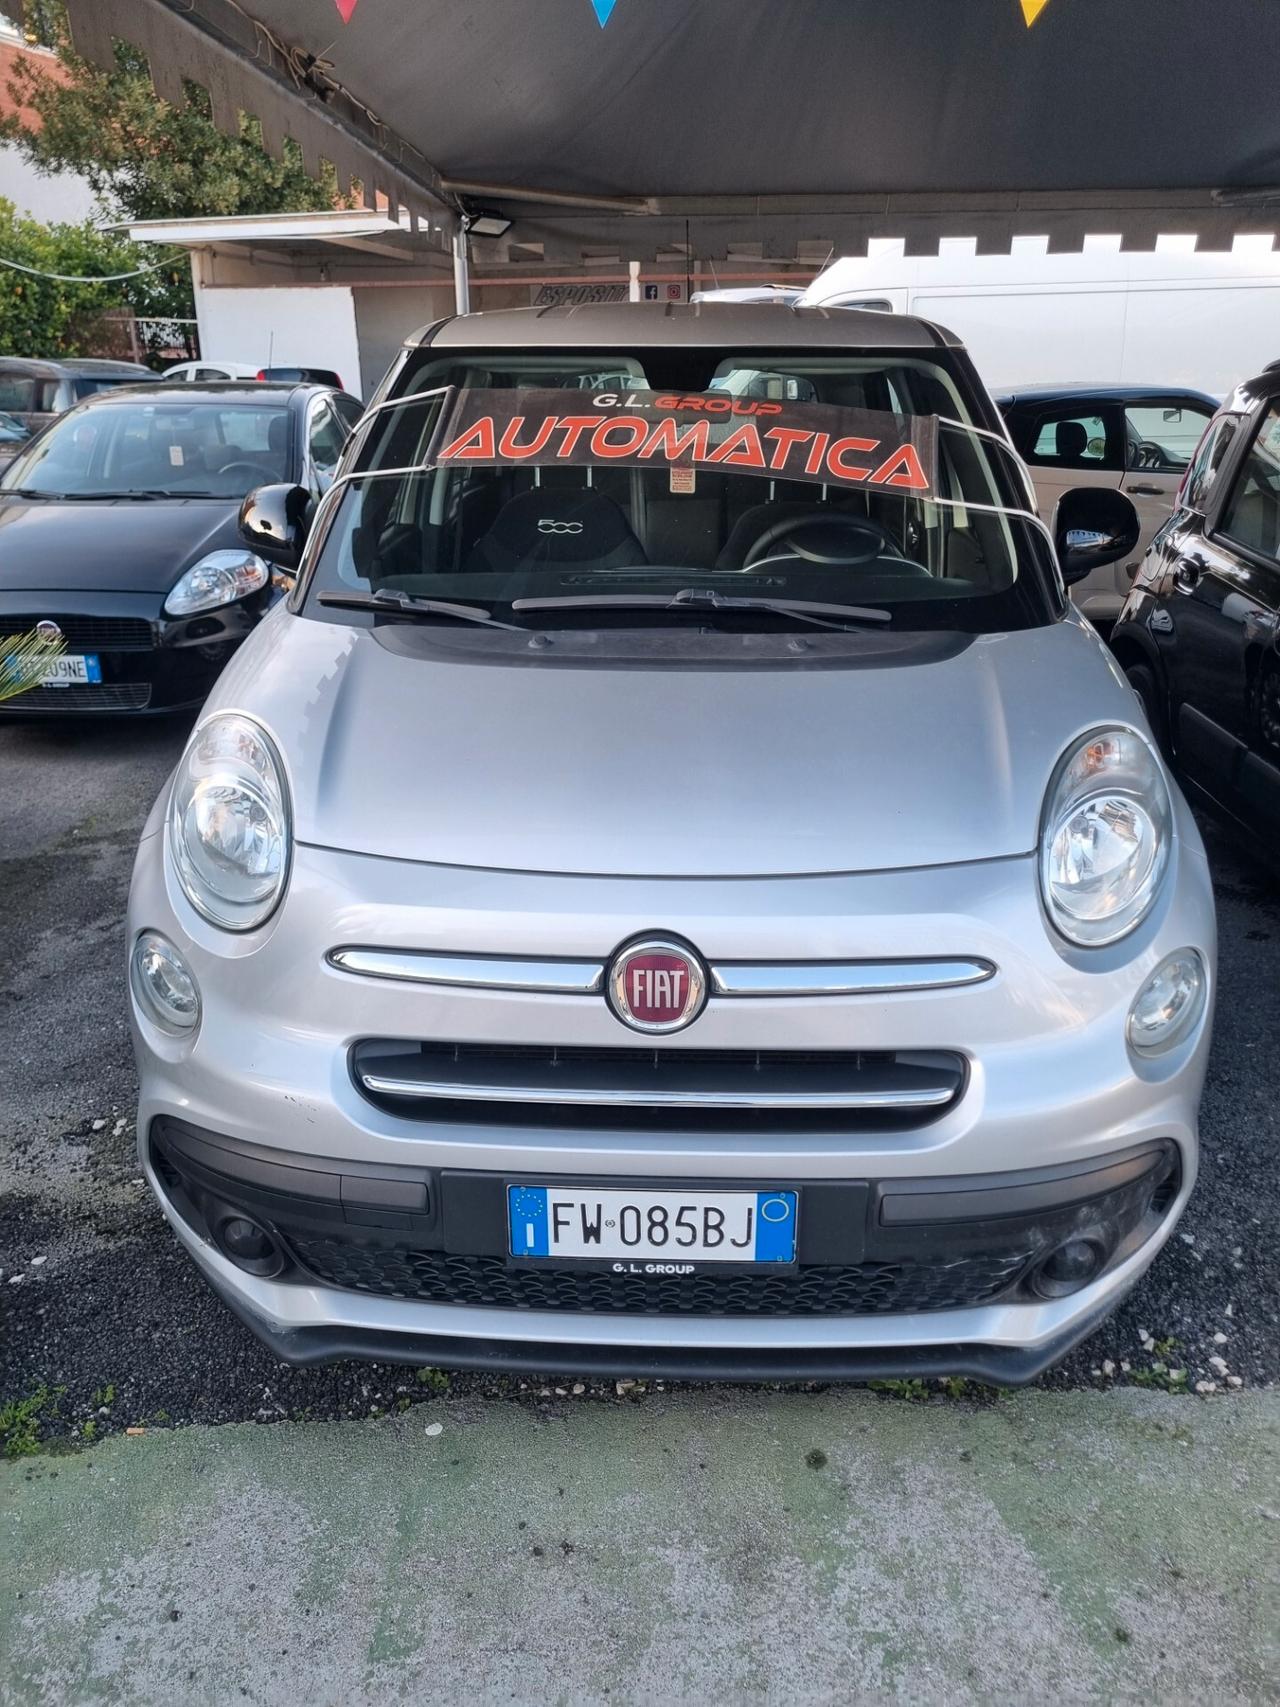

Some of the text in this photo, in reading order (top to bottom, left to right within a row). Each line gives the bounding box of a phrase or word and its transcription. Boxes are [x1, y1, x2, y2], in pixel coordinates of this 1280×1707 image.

[437, 415, 930, 490] AUTOMATICA
[537, 519, 584, 534] 500
[632, 969, 685, 1009] FIAT
[645, 1264, 695, 1274] GROUP
